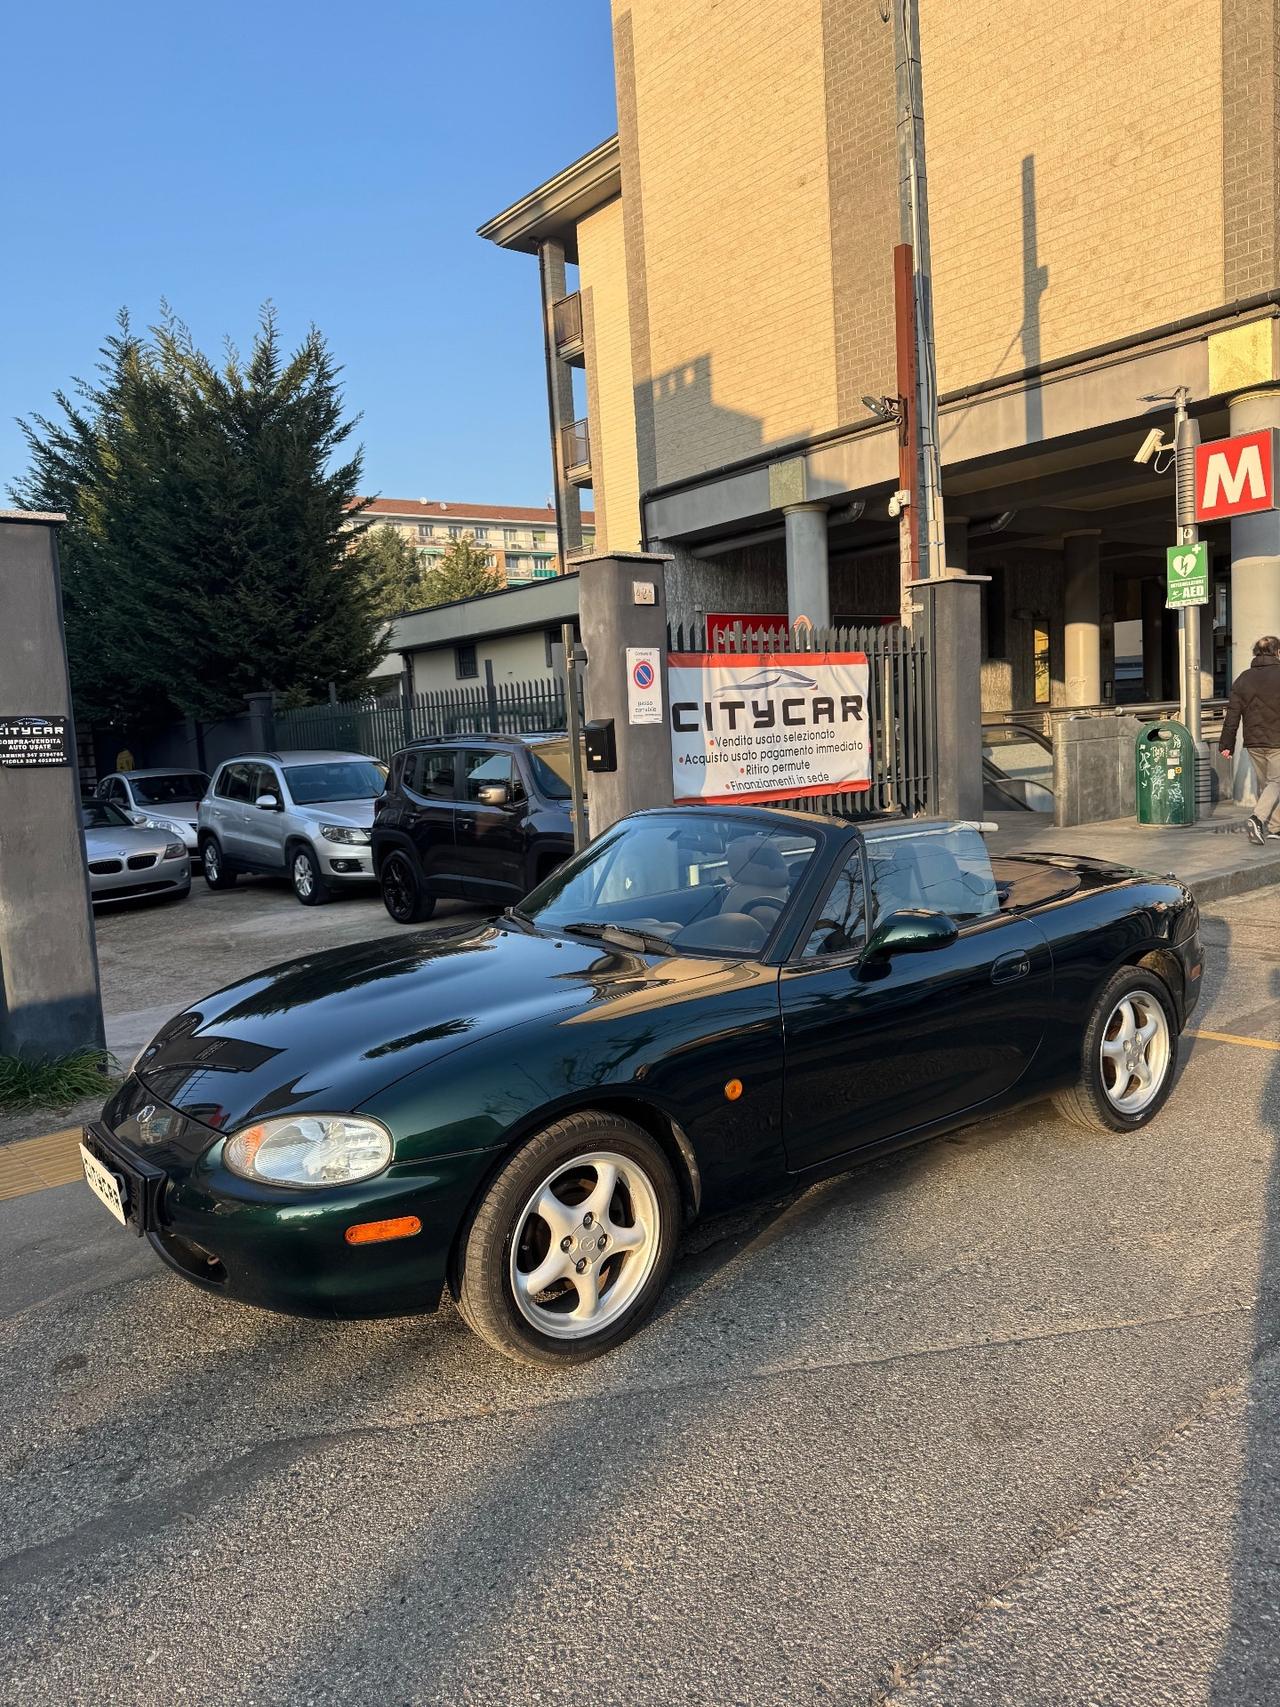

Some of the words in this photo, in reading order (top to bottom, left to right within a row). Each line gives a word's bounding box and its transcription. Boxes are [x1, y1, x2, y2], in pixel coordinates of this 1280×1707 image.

[1202, 445, 1267, 509] M
[1182, 585, 1204, 599] AED
[671, 695, 863, 732] CITYCAR
[714, 735, 754, 748] Vendita
[755, 733, 782, 745] usato
[783, 729, 836, 742] selezionato
[684, 750, 729, 766] Acquisto
[731, 750, 758, 763] usato
[760, 745, 814, 762] pagamento
[815, 741, 864, 755] immediato
[746, 763, 770, 776] Ritiro
[772, 760, 811, 777] permute
[730, 775, 795, 791] Finanziamenti
[796, 775, 806, 785] in
[807, 772, 830, 784] sede
